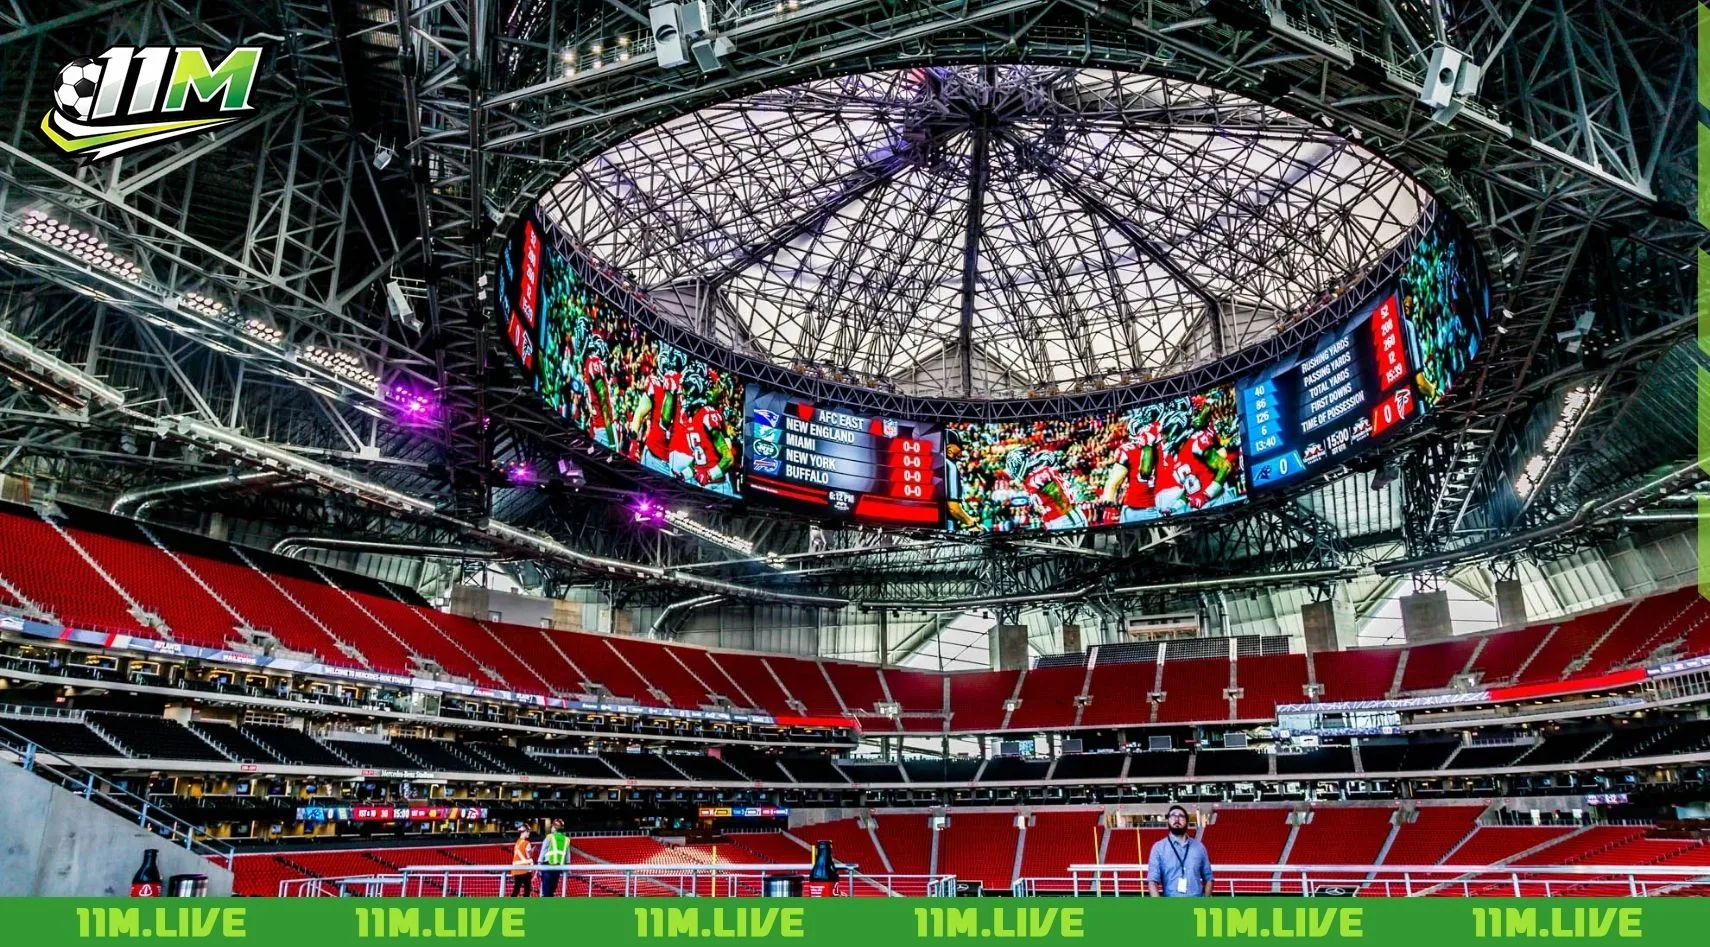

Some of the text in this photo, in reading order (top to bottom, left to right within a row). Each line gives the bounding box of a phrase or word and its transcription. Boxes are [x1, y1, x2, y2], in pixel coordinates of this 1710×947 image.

[1301, 337, 1350, 374] RUSHING YARDS
[1303, 351, 1351, 387] PASSING YARDS
[1255, 385, 1265, 397] 40
[1309, 368, 1350, 399] TOTAL YARDS
[1256, 399, 1266, 411] 86
[1311, 383, 1352, 413] FIRST DOWNS
[819, 410, 864, 430] AFC EAST
[1256, 412, 1269, 424] 126
[1301, 390, 1365, 433] TIME OF POSSESSION
[1383, 404, 1392, 424] 0
[786, 418, 855, 443] NEW ENGLAND
[1261, 425, 1268, 436] 6
[1326, 428, 1349, 450] 15:00
[786, 433, 816, 451] MIAMI
[903, 441, 921, 453] 0-0
[1255, 436, 1277, 452] 13:40
[786, 448, 836, 469] NEW YORK
[903, 455, 921, 468] 0-0
[1279, 458, 1288, 475] 0
[786, 464, 829, 485] BUFFALO
[904, 470, 921, 482] 0-0
[844, 494, 855, 503] PM
[904, 485, 922, 497] 0-0
[381, 769, 415, 778] Mercedes-Benz
